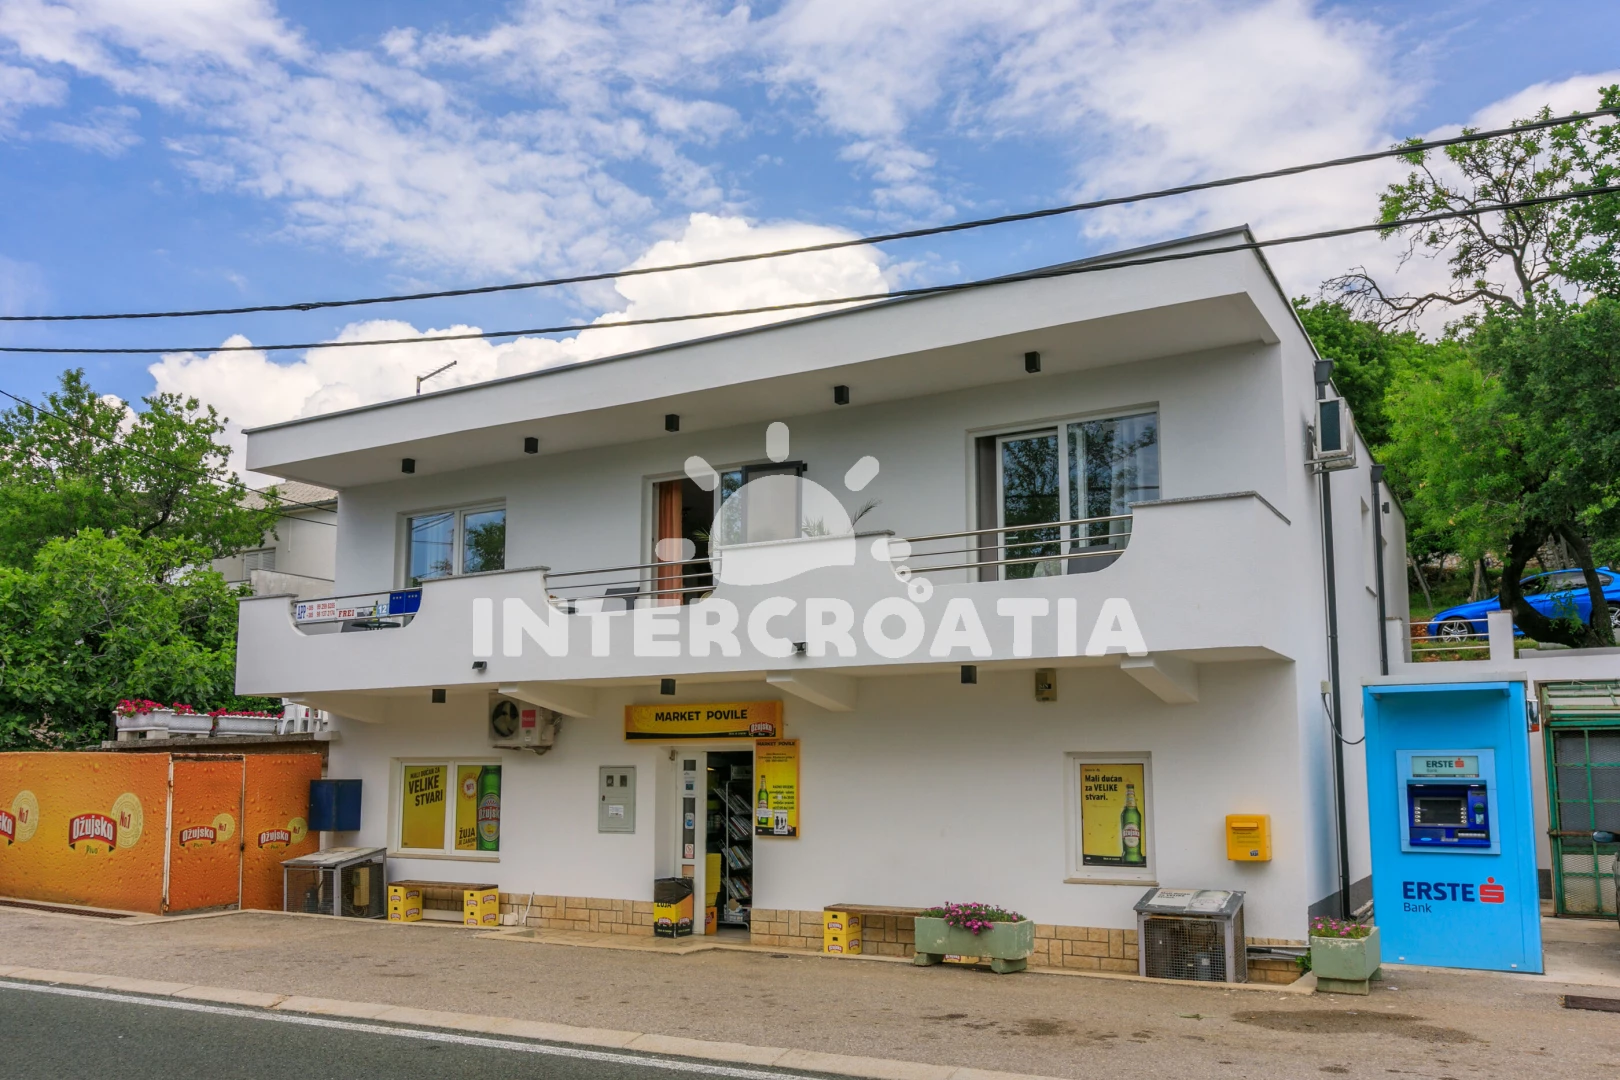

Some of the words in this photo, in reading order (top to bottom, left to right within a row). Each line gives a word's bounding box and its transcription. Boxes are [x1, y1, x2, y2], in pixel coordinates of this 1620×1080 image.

[338, 608, 355, 618] FREI
[378, 605, 387, 613] 12
[655, 711, 701, 722] MARKET
[706, 709, 748, 720] POVILE
[1426, 760, 1454, 768] ERSTE
[409, 775, 440, 795] VELIKE
[1085, 775, 1100, 783] Mali
[1101, 774, 1123, 783] dućan
[1093, 784, 1118, 792] VELIKE
[415, 789, 443, 807] STVARI
[1085, 793, 1108, 801] stvari.
[72, 815, 114, 841] Ožujsko
[182, 826, 214, 842] Ožujsko
[459, 827, 475, 840] ŽUJA
[261, 830, 289, 844] Ožujsko
[1402, 881, 1476, 902] ERSTE
[1403, 902, 1432, 913] Bank
